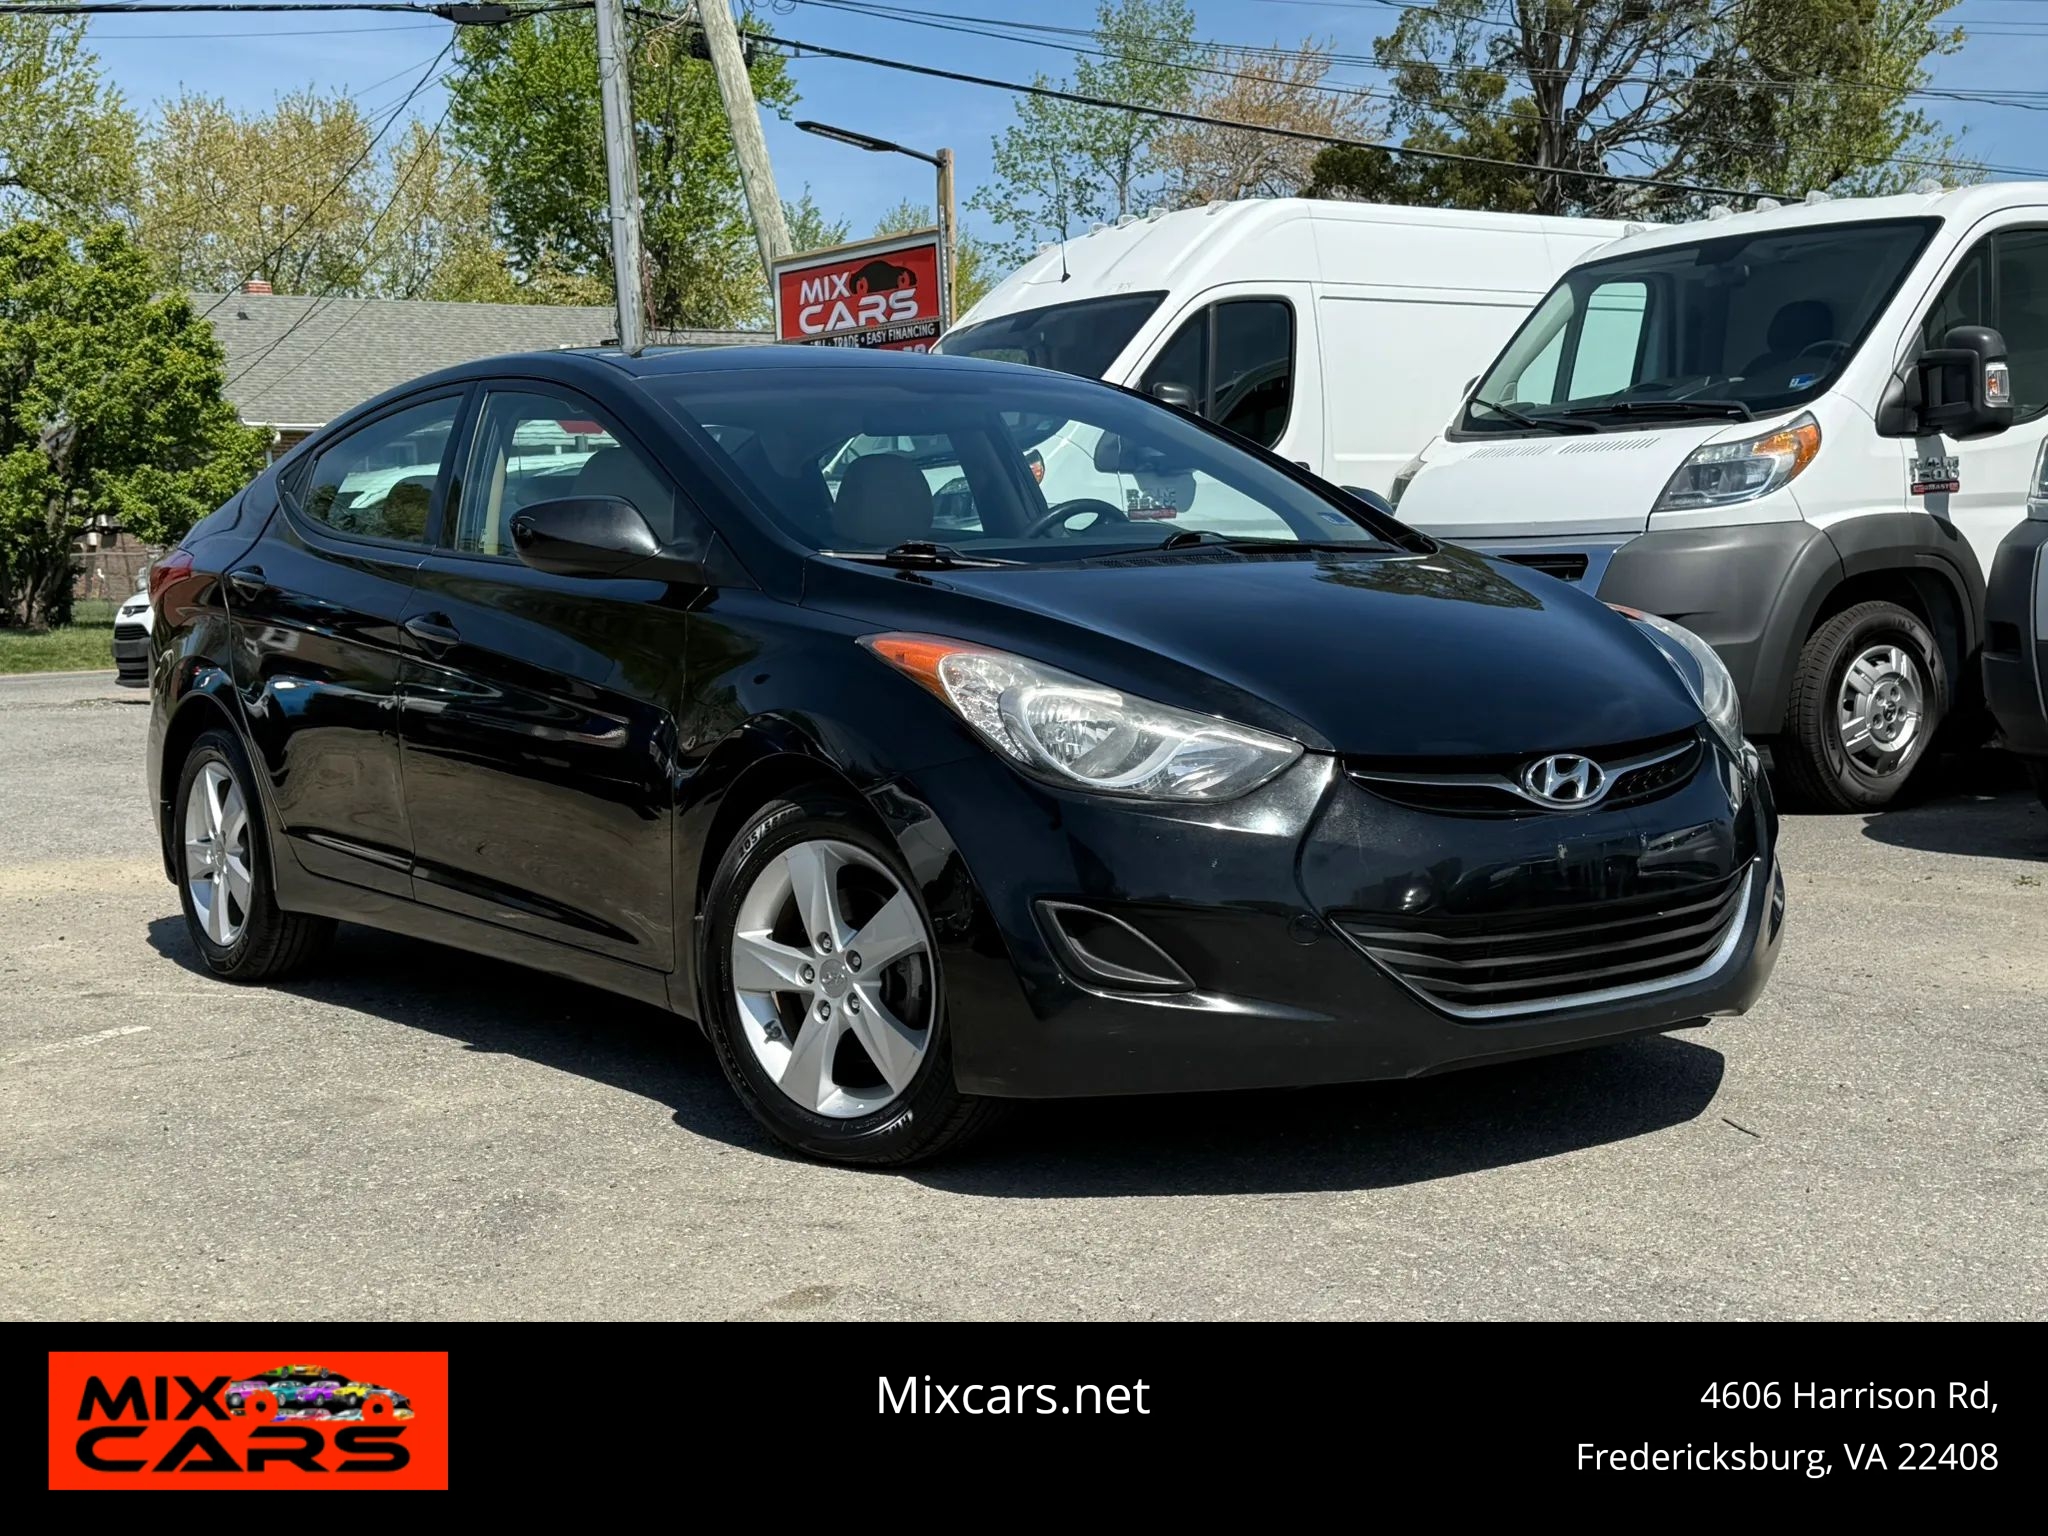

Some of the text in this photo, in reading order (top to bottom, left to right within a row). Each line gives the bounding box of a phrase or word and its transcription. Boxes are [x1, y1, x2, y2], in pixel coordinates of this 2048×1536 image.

[800, 271, 851, 305] MIX
[799, 288, 918, 334] CARS
[833, 333, 859, 349] TRADE
[866, 330, 888, 345] EASY
[889, 323, 935, 340] FINANCING
